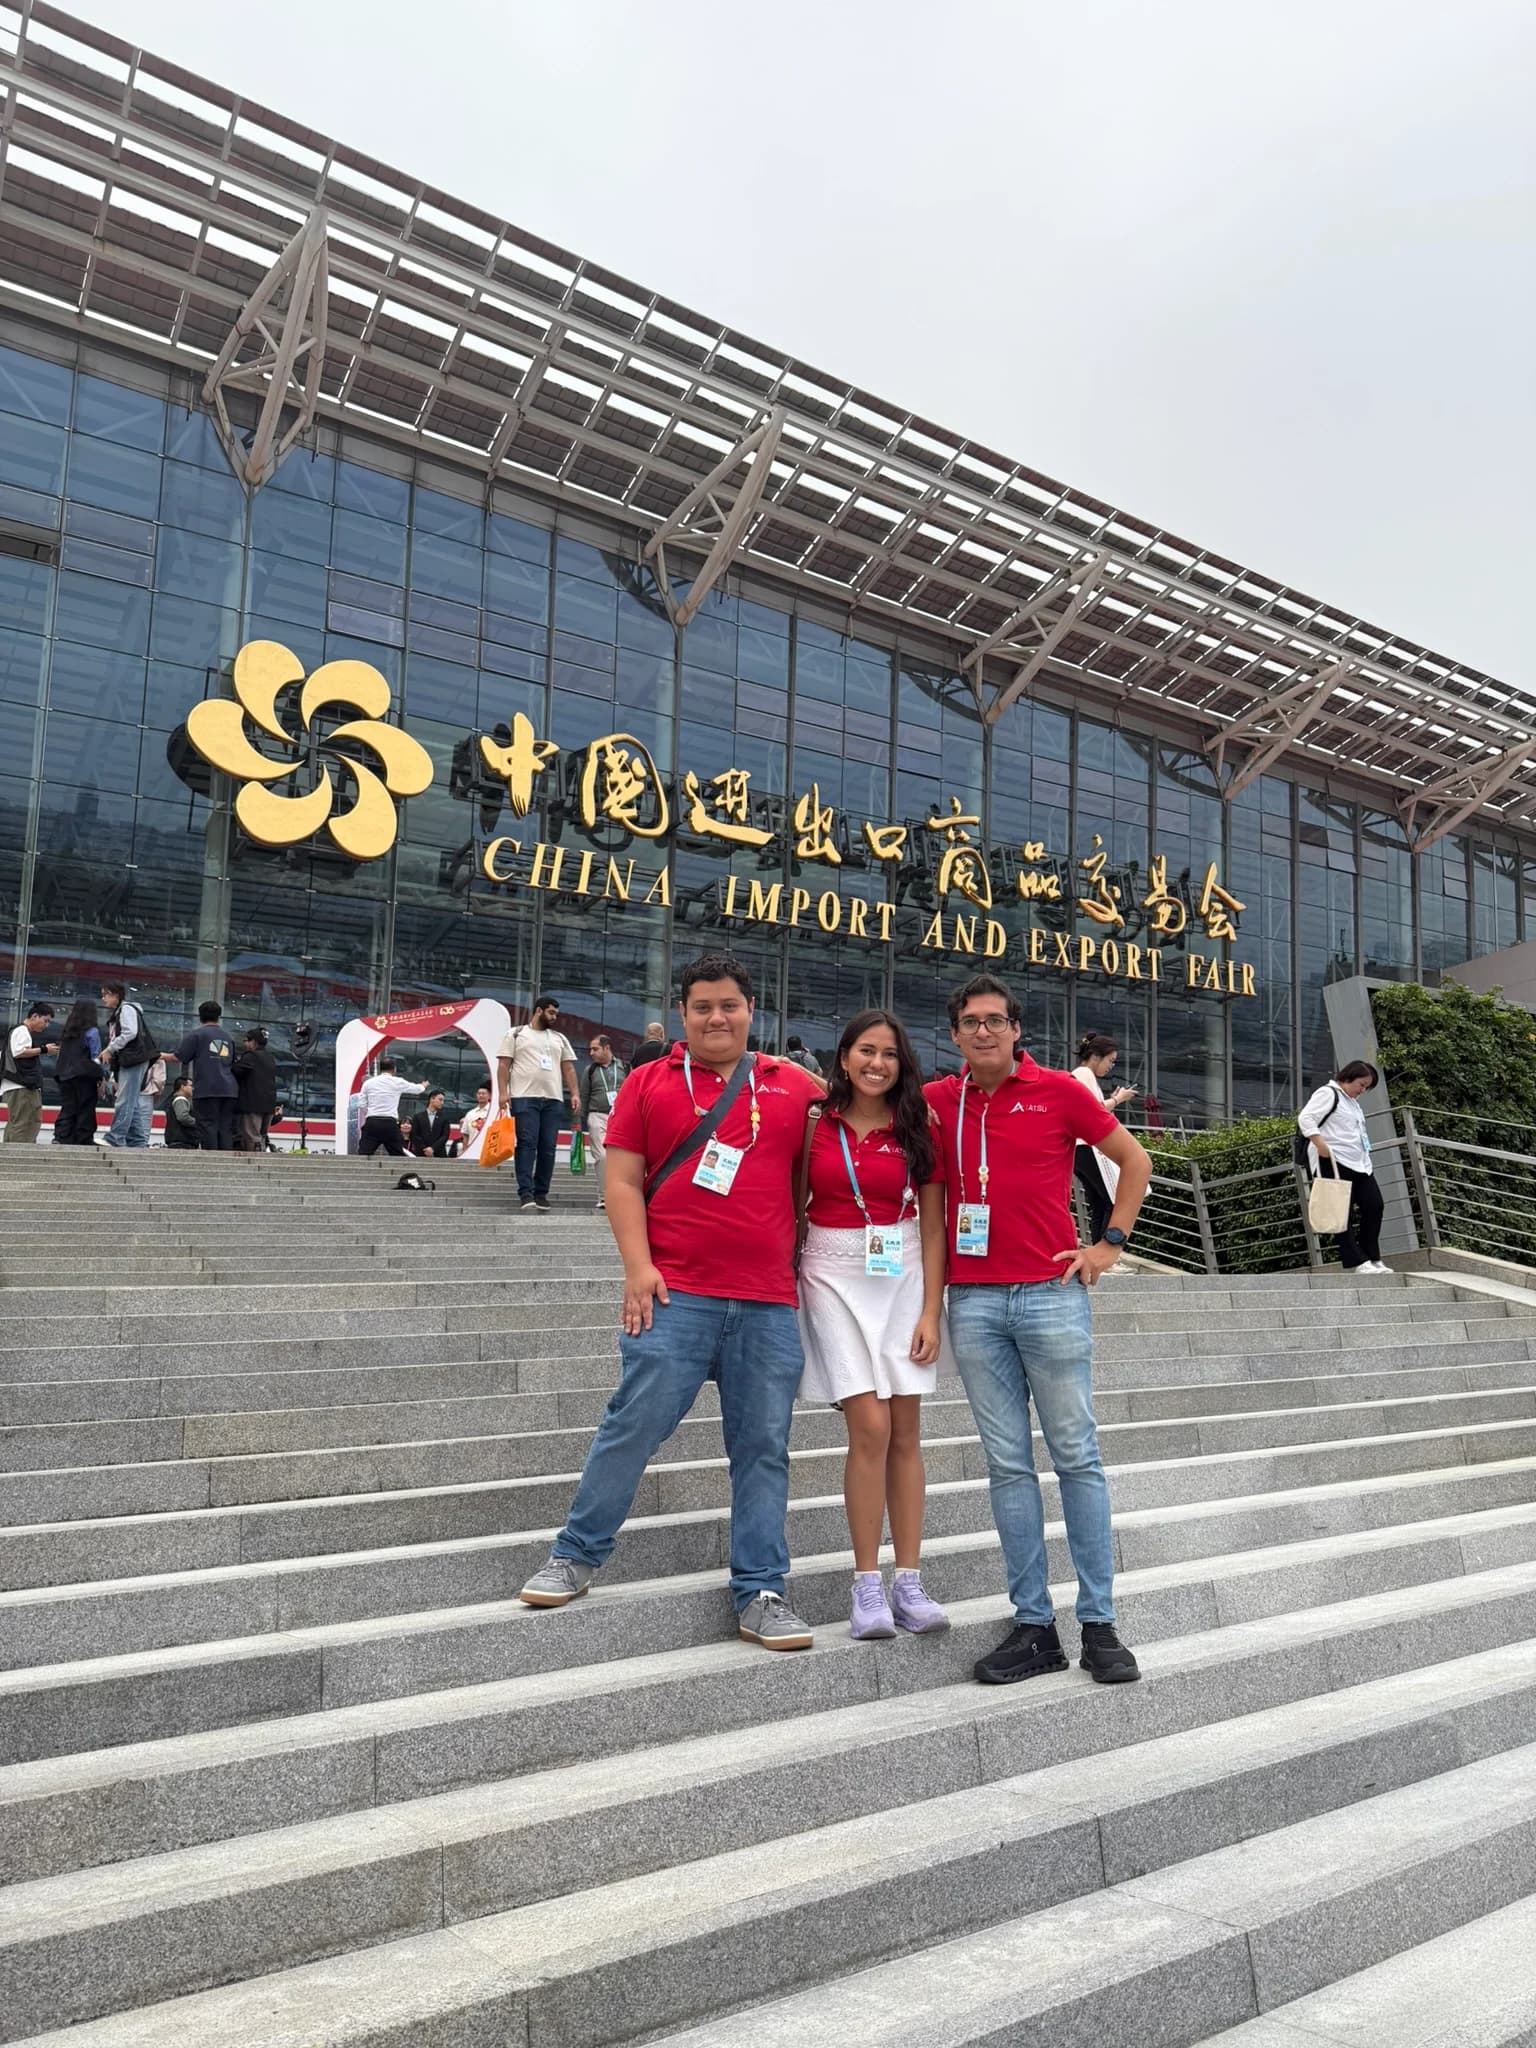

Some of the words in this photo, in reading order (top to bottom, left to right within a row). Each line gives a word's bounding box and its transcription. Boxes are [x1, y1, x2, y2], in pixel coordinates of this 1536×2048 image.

[482, 837, 672, 907] CHINA
[723, 875, 896, 941] IMPORT
[921, 911, 1007, 957] AND
[1029, 928, 1163, 982] EXPORT
[1187, 953, 1257, 996] FAIR
